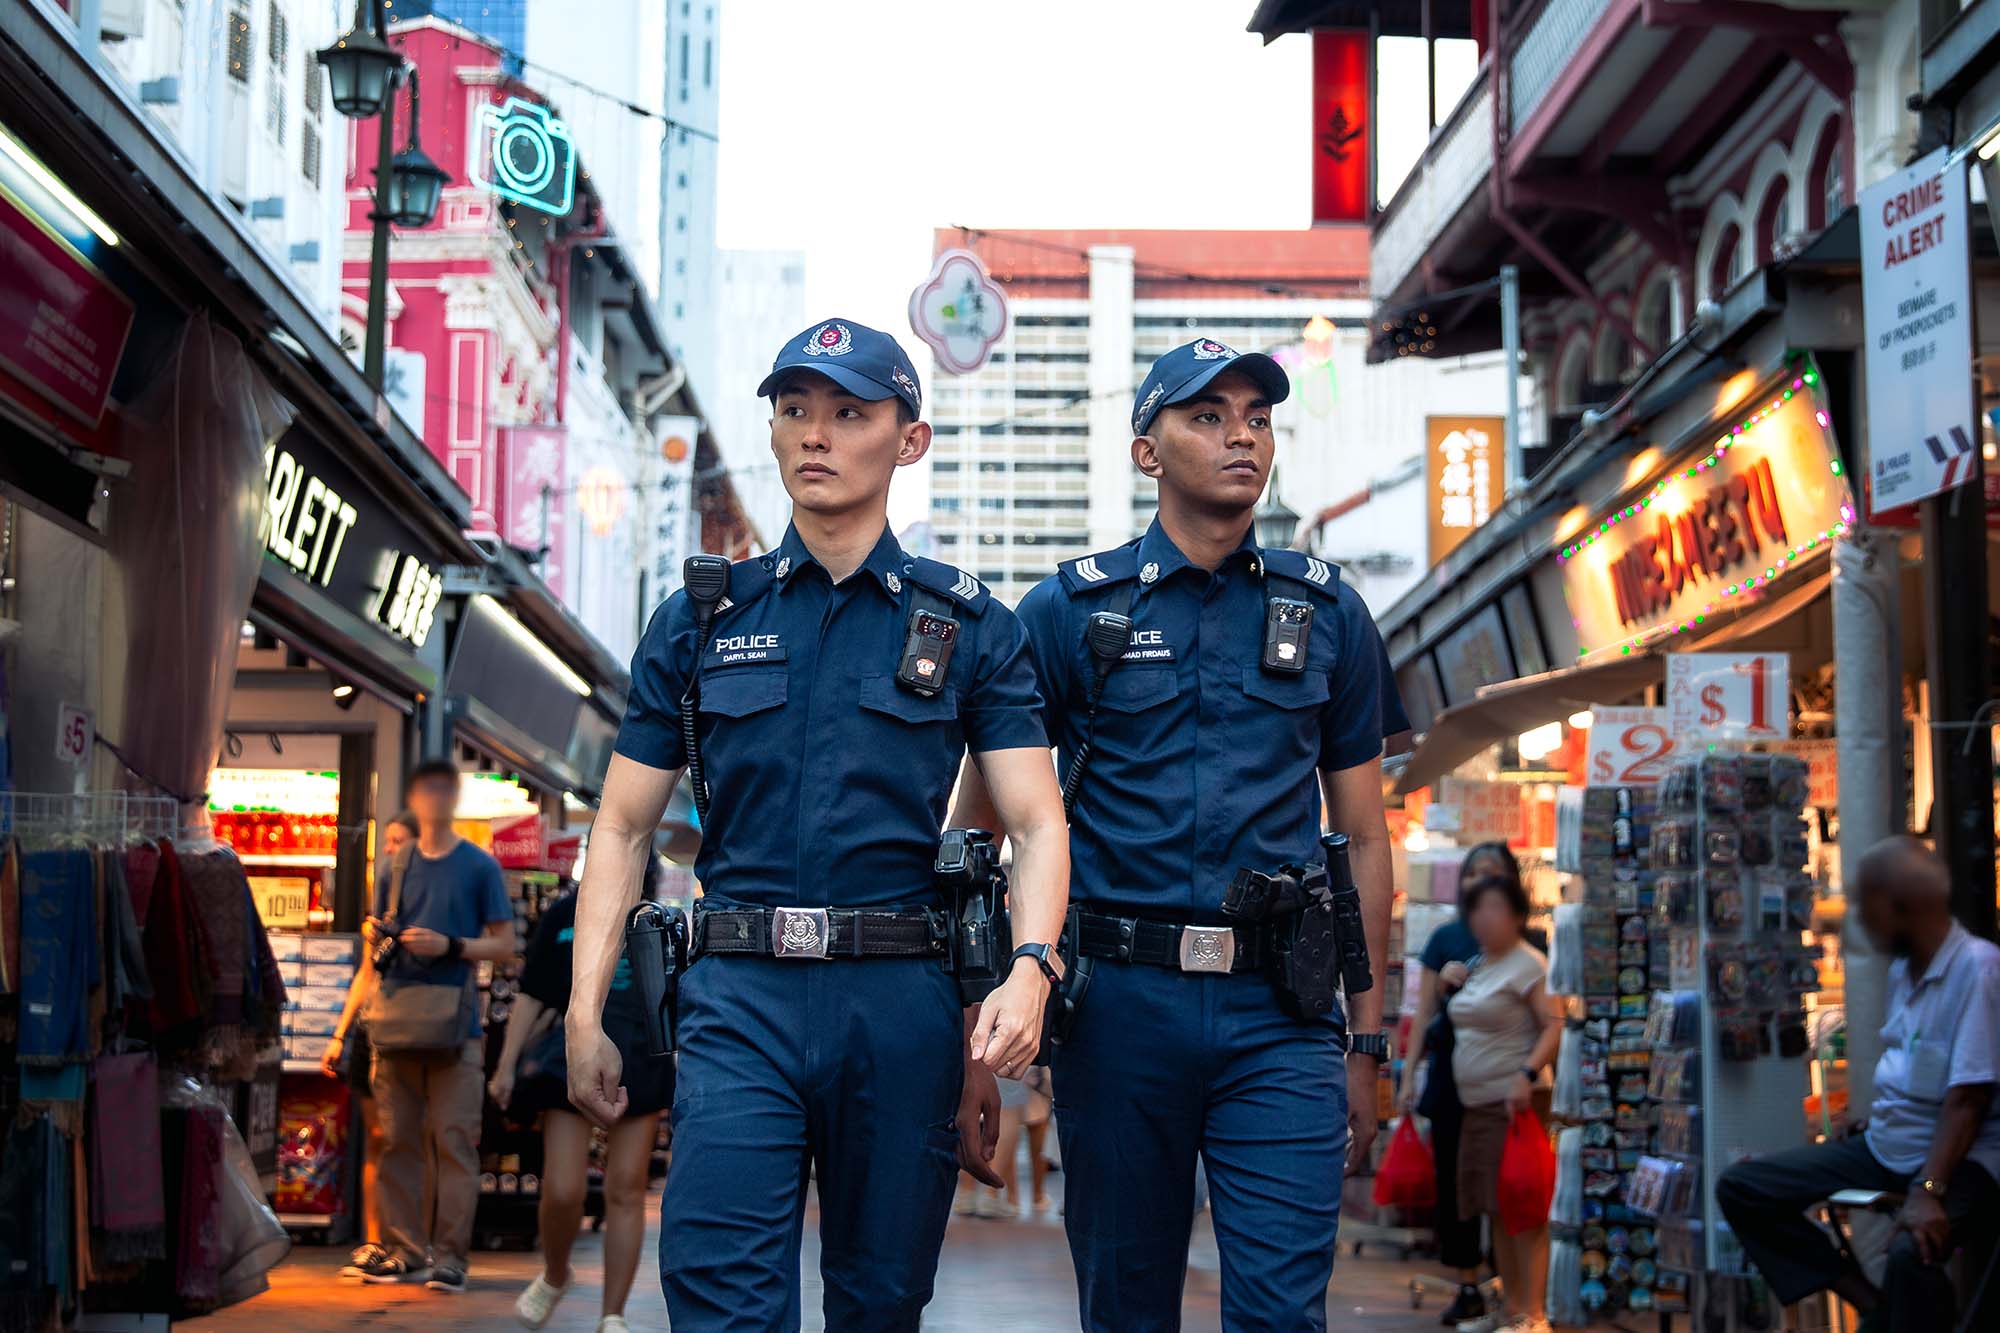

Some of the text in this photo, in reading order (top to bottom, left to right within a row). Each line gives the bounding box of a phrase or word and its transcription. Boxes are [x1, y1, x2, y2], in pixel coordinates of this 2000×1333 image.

[1883, 173, 1944, 228] CRIME
[1885, 212, 1945, 269] ALERT
[1898, 287, 1937, 320] BEWARE
[715, 635, 778, 652] POLICE
[1130, 630, 1163, 646] ICE
[1142, 649, 1171, 659] FIRDAUS
[723, 651, 767, 662] DARYL SEAH
[64, 715, 86, 754] $5
[1593, 725, 1675, 783] $2
